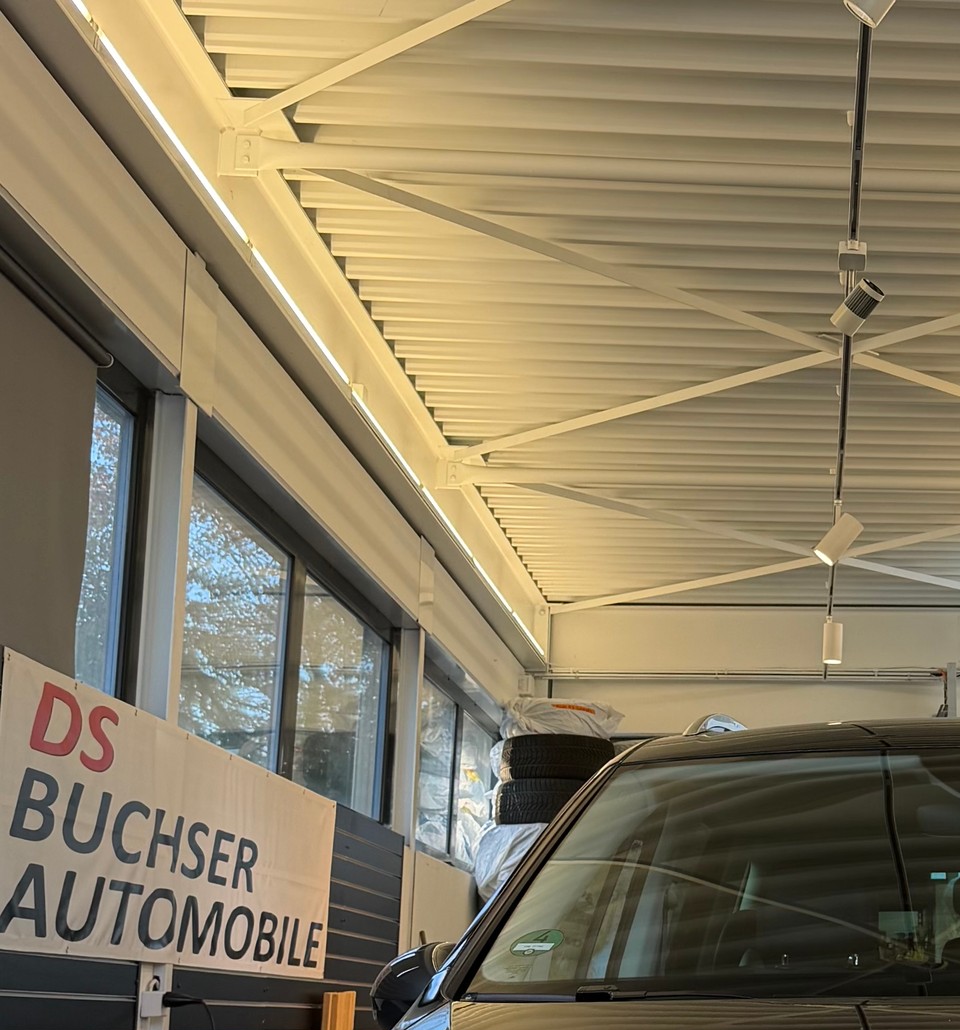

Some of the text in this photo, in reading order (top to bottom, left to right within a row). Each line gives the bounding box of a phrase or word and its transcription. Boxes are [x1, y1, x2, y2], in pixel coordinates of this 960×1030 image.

[30, 681, 119, 773] DS
[9, 767, 259, 893] BUCHSER
[0, 863, 324, 968] AUTOMOBILE
